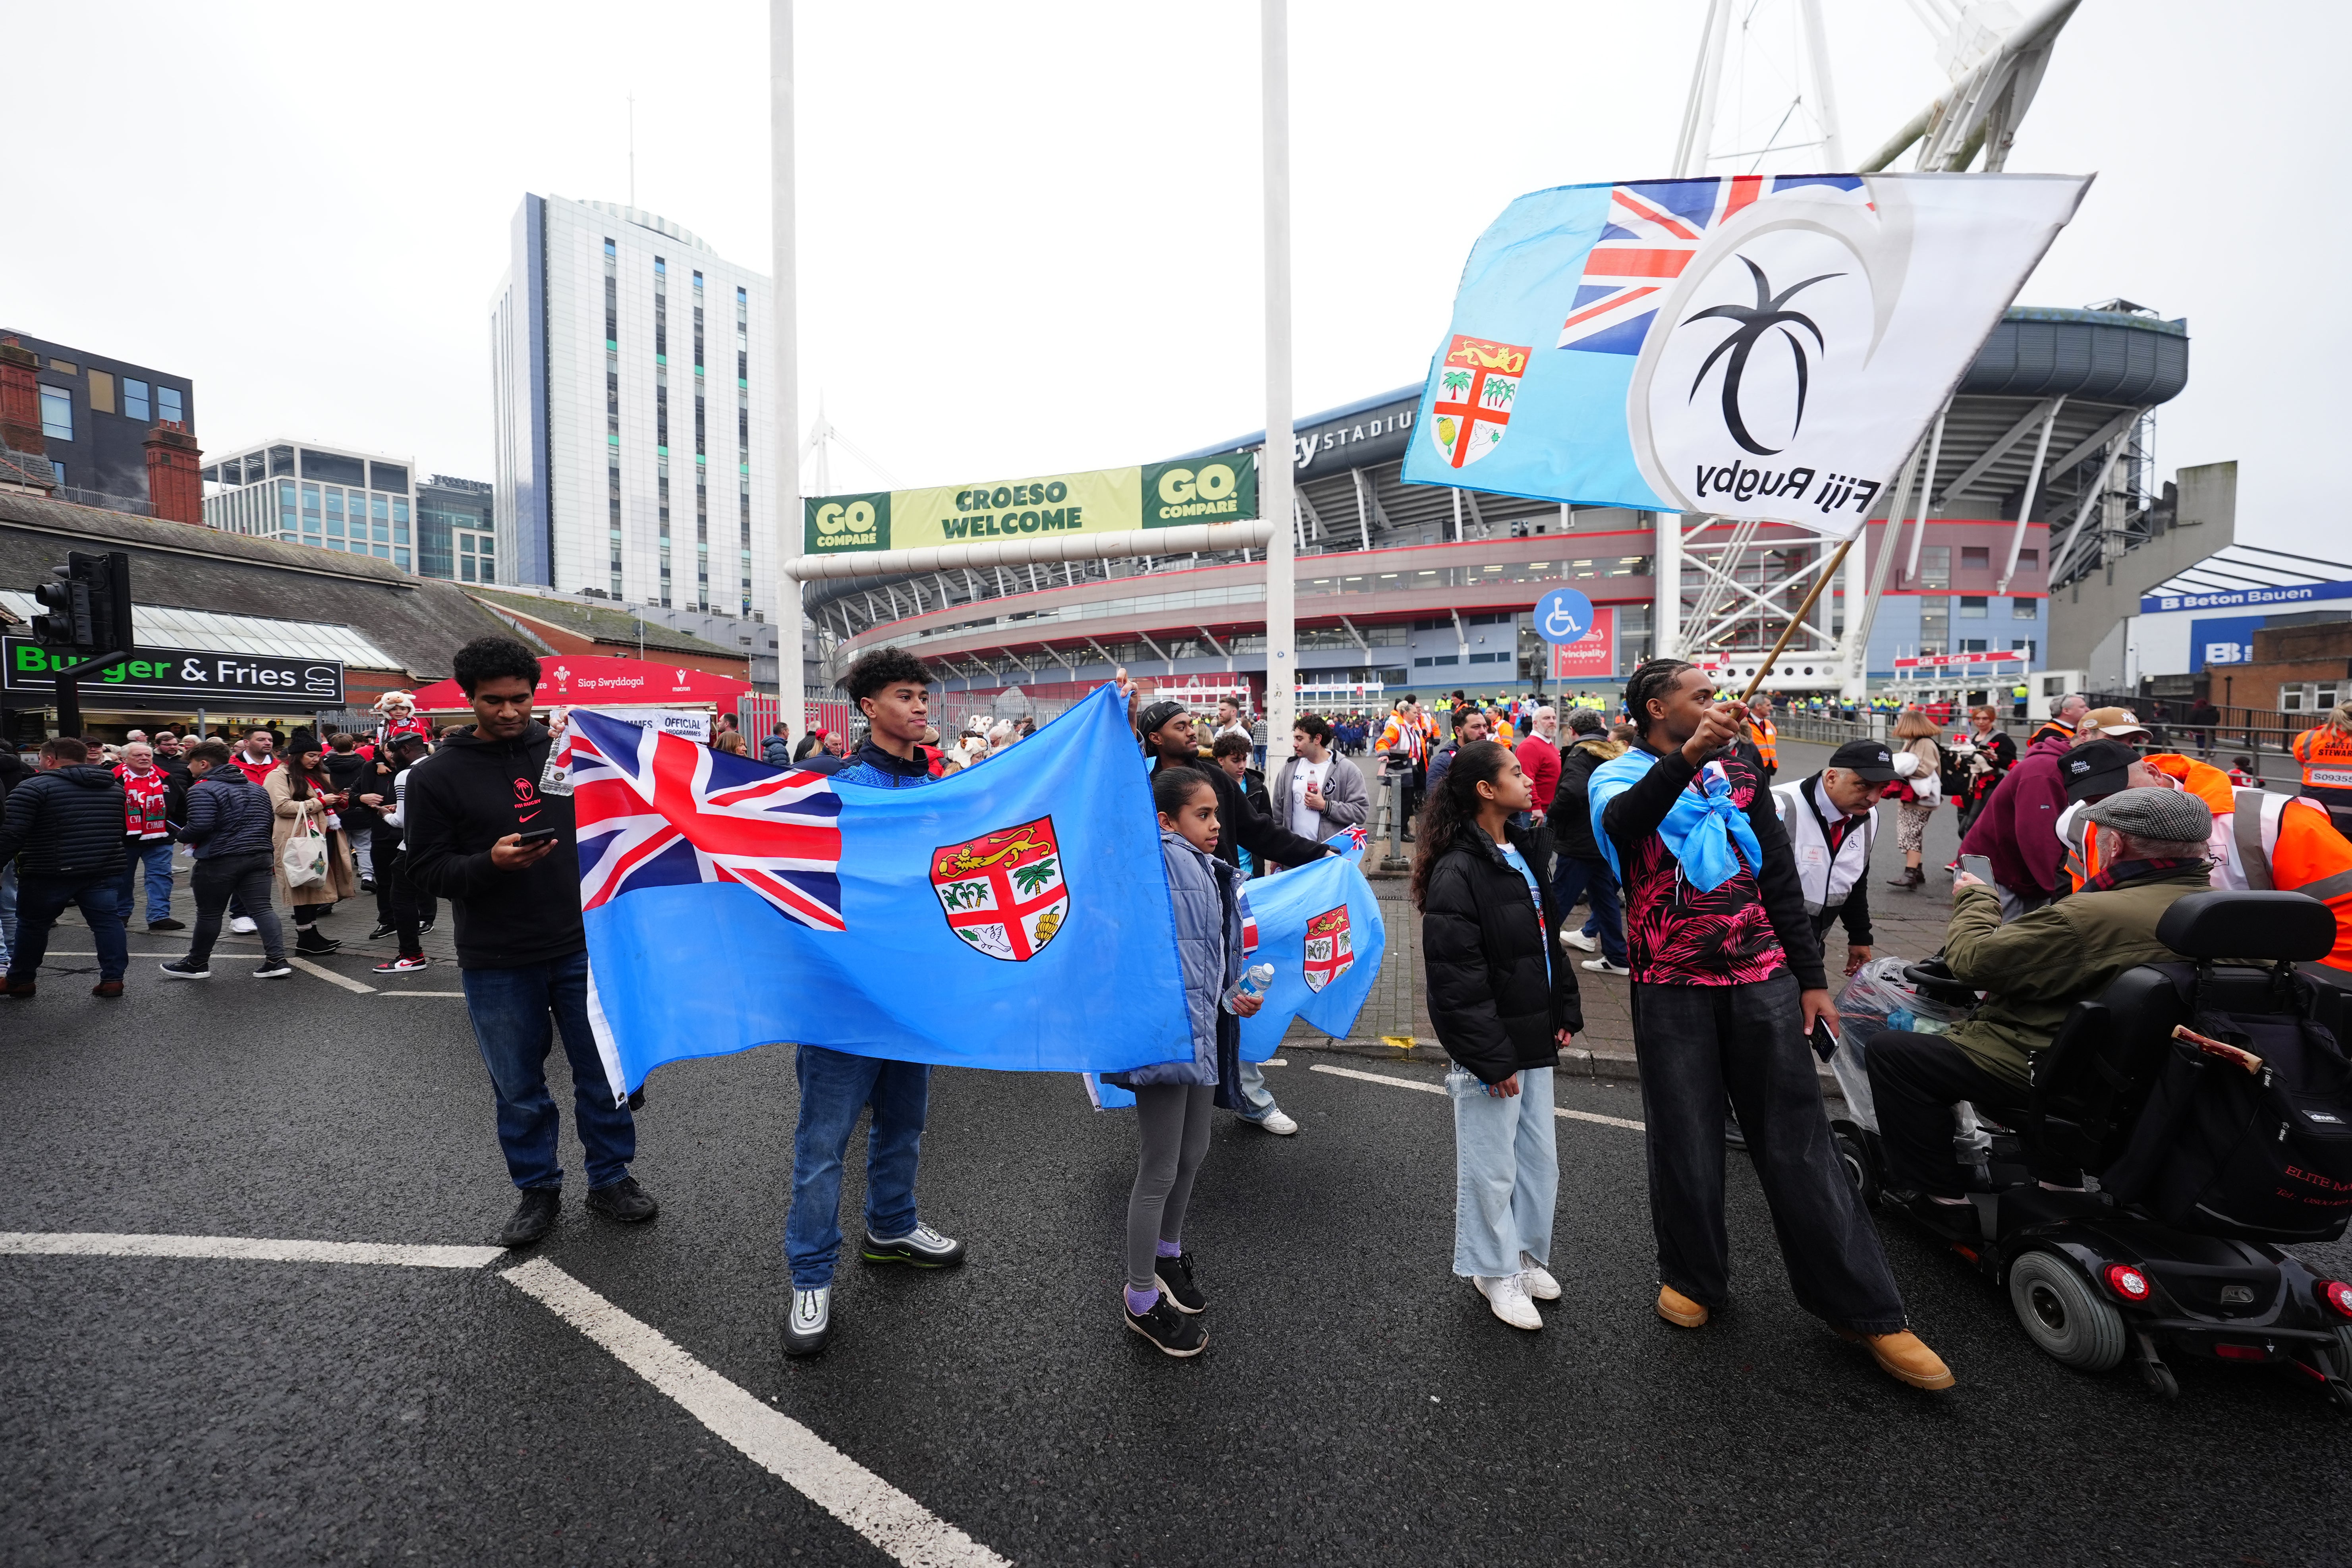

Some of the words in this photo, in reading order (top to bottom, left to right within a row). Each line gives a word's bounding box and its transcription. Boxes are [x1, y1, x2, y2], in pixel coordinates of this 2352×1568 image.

[1293, 433, 1319, 469] ty
[1324, 411, 1411, 449] STADIU
[1159, 464, 1237, 504] GO.
[956, 481, 1067, 512] CROESO
[816, 501, 877, 535] GO.
[1159, 500, 1237, 519] COMPARE
[941, 507, 1082, 539] WELCOME
[817, 533, 876, 547] COMPARE
[2184, 593, 2244, 607] Beton
[2248, 589, 2312, 602] Bauen
[1562, 649, 1607, 659] Principality
[1948, 655, 1971, 664] Gate
[181, 658, 208, 681] &
[218, 661, 296, 686] Fries
[578, 679, 596, 689] Siop
[598, 676, 644, 688] Swyddogol
[664, 717, 700, 729] OFFICIAL
[2285, 1165, 2330, 1187] ELITE
[2276, 1187, 2297, 1200] Tel:
